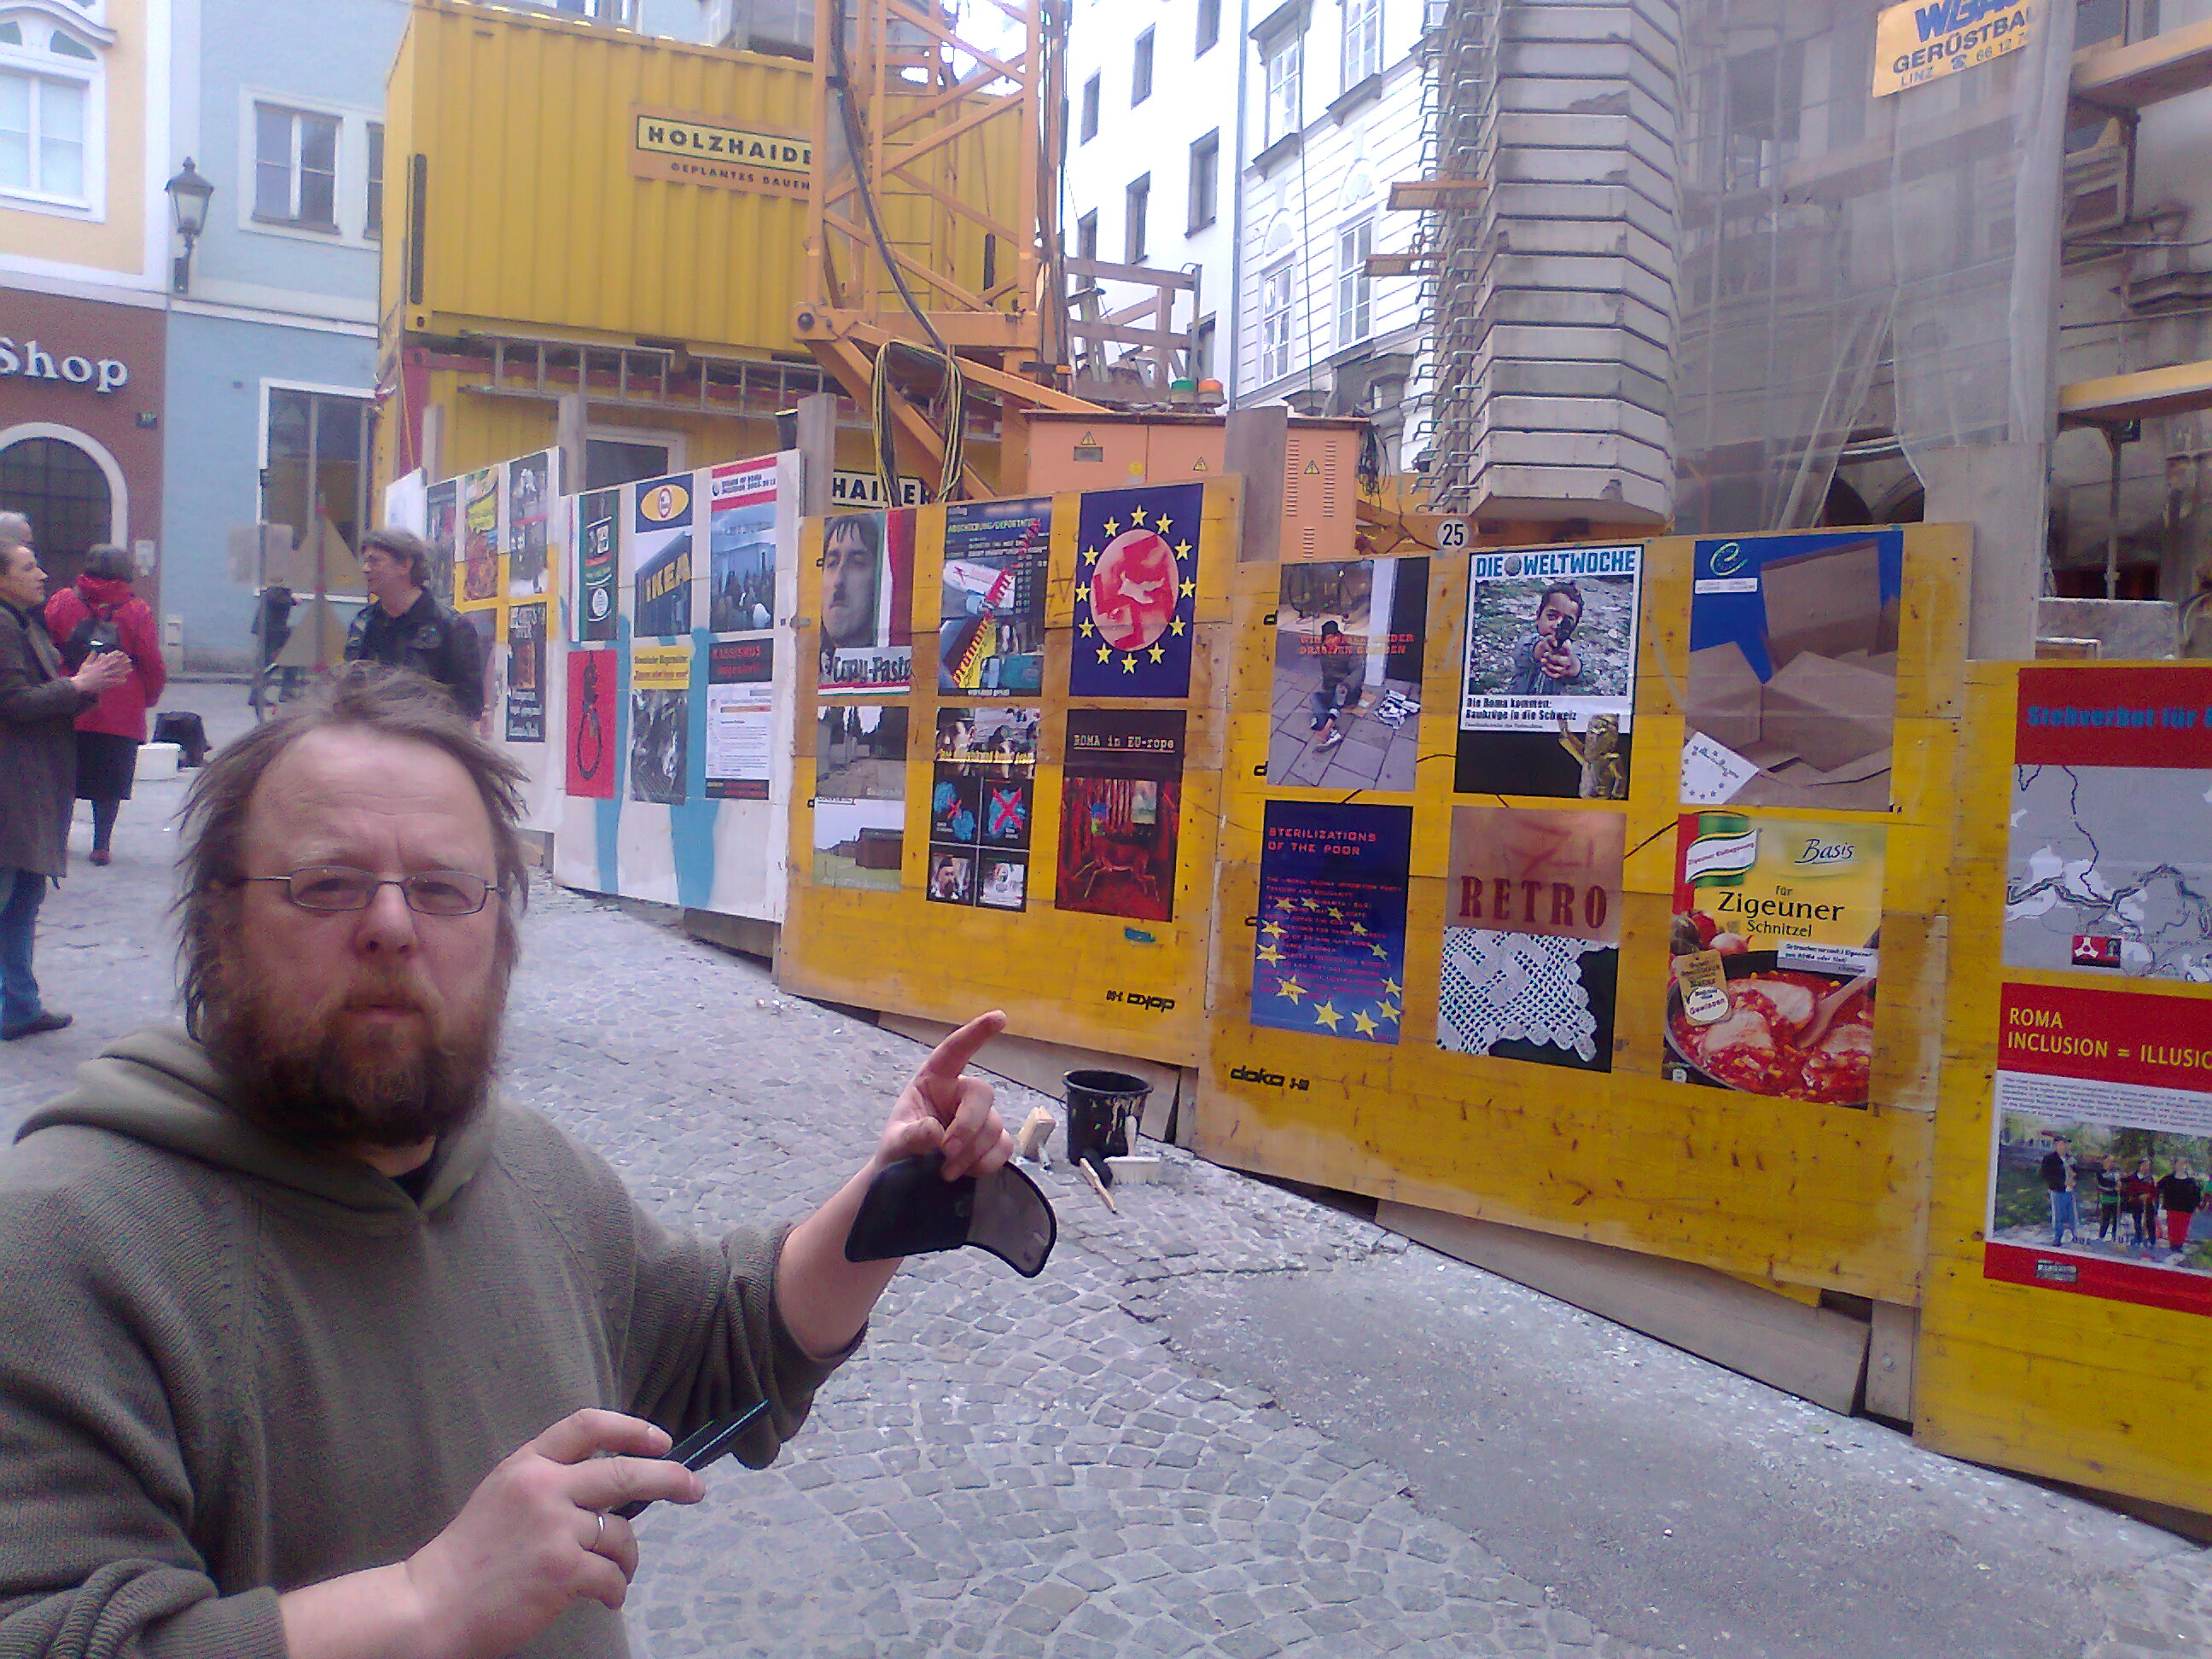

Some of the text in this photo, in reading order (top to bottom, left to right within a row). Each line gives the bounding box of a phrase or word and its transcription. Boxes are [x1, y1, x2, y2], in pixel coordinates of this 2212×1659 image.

[1901, 67, 1935, 86] LINZ
[0, 337, 127, 393] Shop
[1443, 523, 1464, 546] 25
[1476, 550, 1636, 577] DIE WELTWOCHE
[644, 552, 693, 602] IKEA
[1467, 697, 1481, 707] Die
[1483, 698, 1508, 708] Roma
[1511, 710, 1519, 720] in
[1522, 710, 1537, 720] die
[1539, 710, 1577, 721] Schweiz
[2027, 705, 2155, 727] Stehverbot
[2163, 707, 2197, 728] für
[1073, 734, 1101, 747] ROMA
[1108, 736, 1121, 747] in
[1268, 826, 1377, 842] STERILIZATIONS
[1267, 841, 1360, 856] OF THE POOR
[1799, 838, 1855, 863] Basis
[1459, 875, 1607, 928] RETRO
[1776, 885, 1794, 896] für
[1718, 891, 1846, 922] Zigeuner
[1747, 919, 1813, 938] Schnitzel
[2009, 1007, 2064, 1030] ROMA
[2008, 1031, 2109, 1059] INCLUSION
[1230, 1064, 1285, 1087] doka
